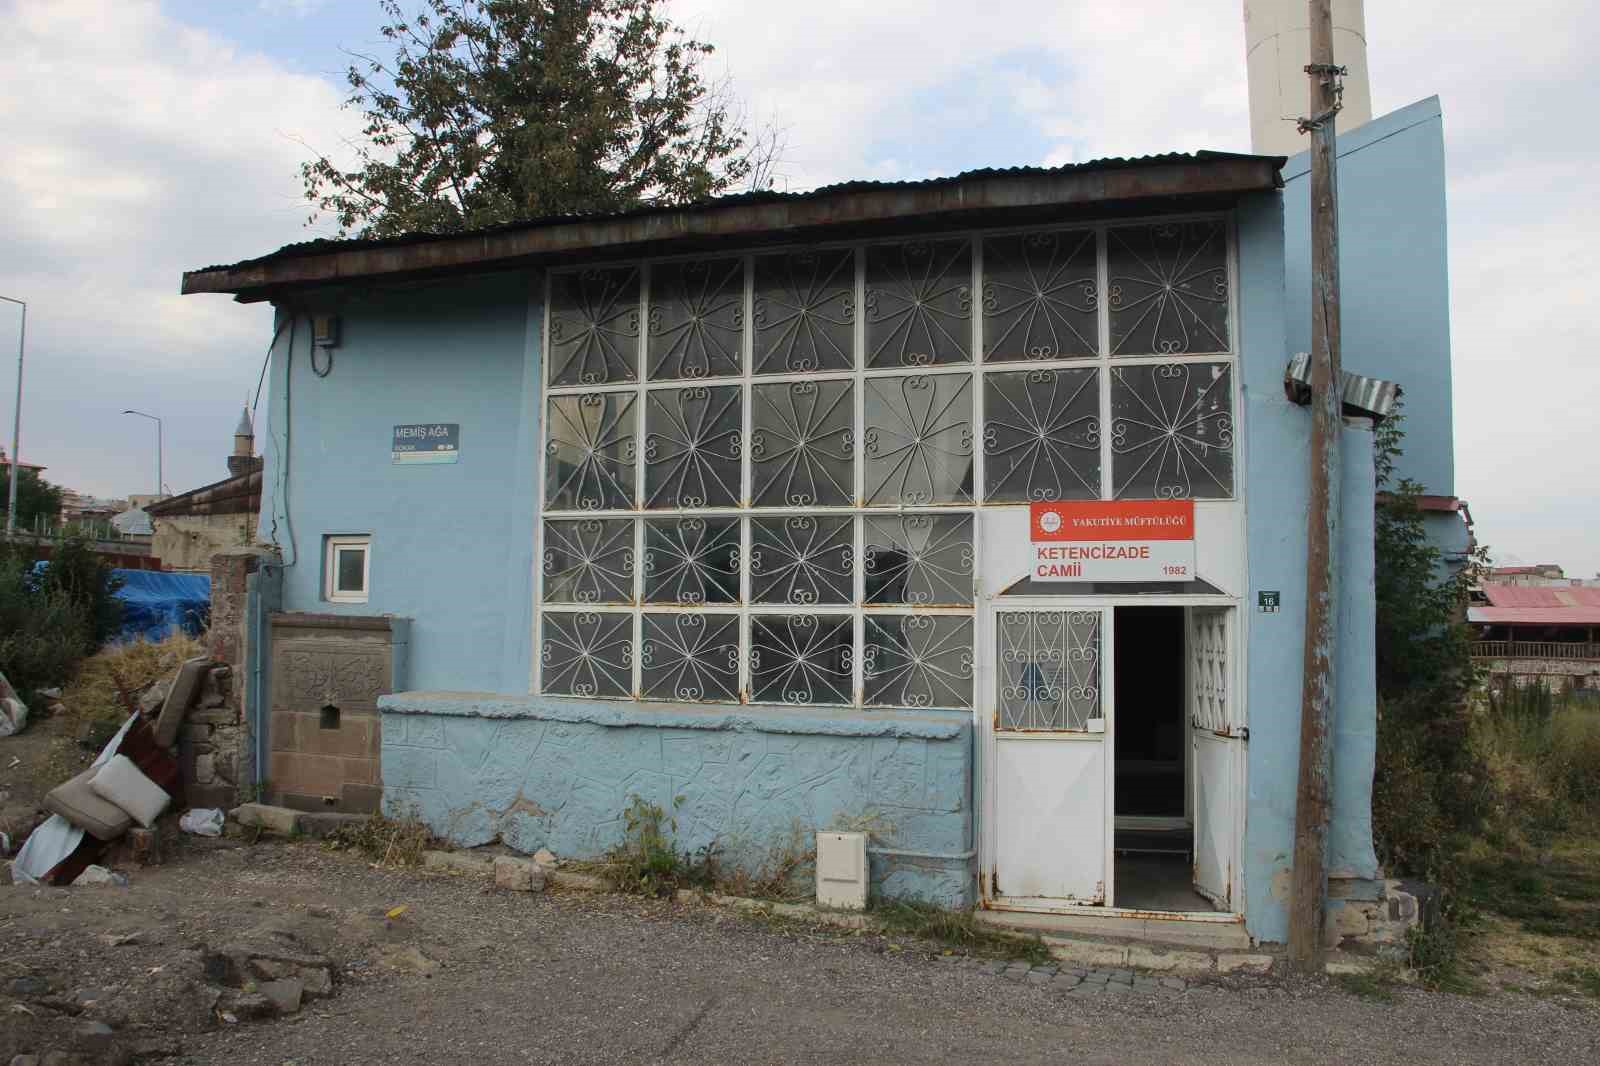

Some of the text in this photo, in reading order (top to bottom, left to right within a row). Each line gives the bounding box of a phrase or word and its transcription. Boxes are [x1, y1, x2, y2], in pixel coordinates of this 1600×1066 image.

[395, 425, 449, 440] MEMİŞ AĞA
[1071, 514, 1186, 527] YAKUTİYE MÜFTÜLÜĞÜ
[1037, 544, 1150, 559] KETENCİZADE
[1037, 562, 1082, 577] CAMİİ
[1162, 566, 1187, 575] 1982
